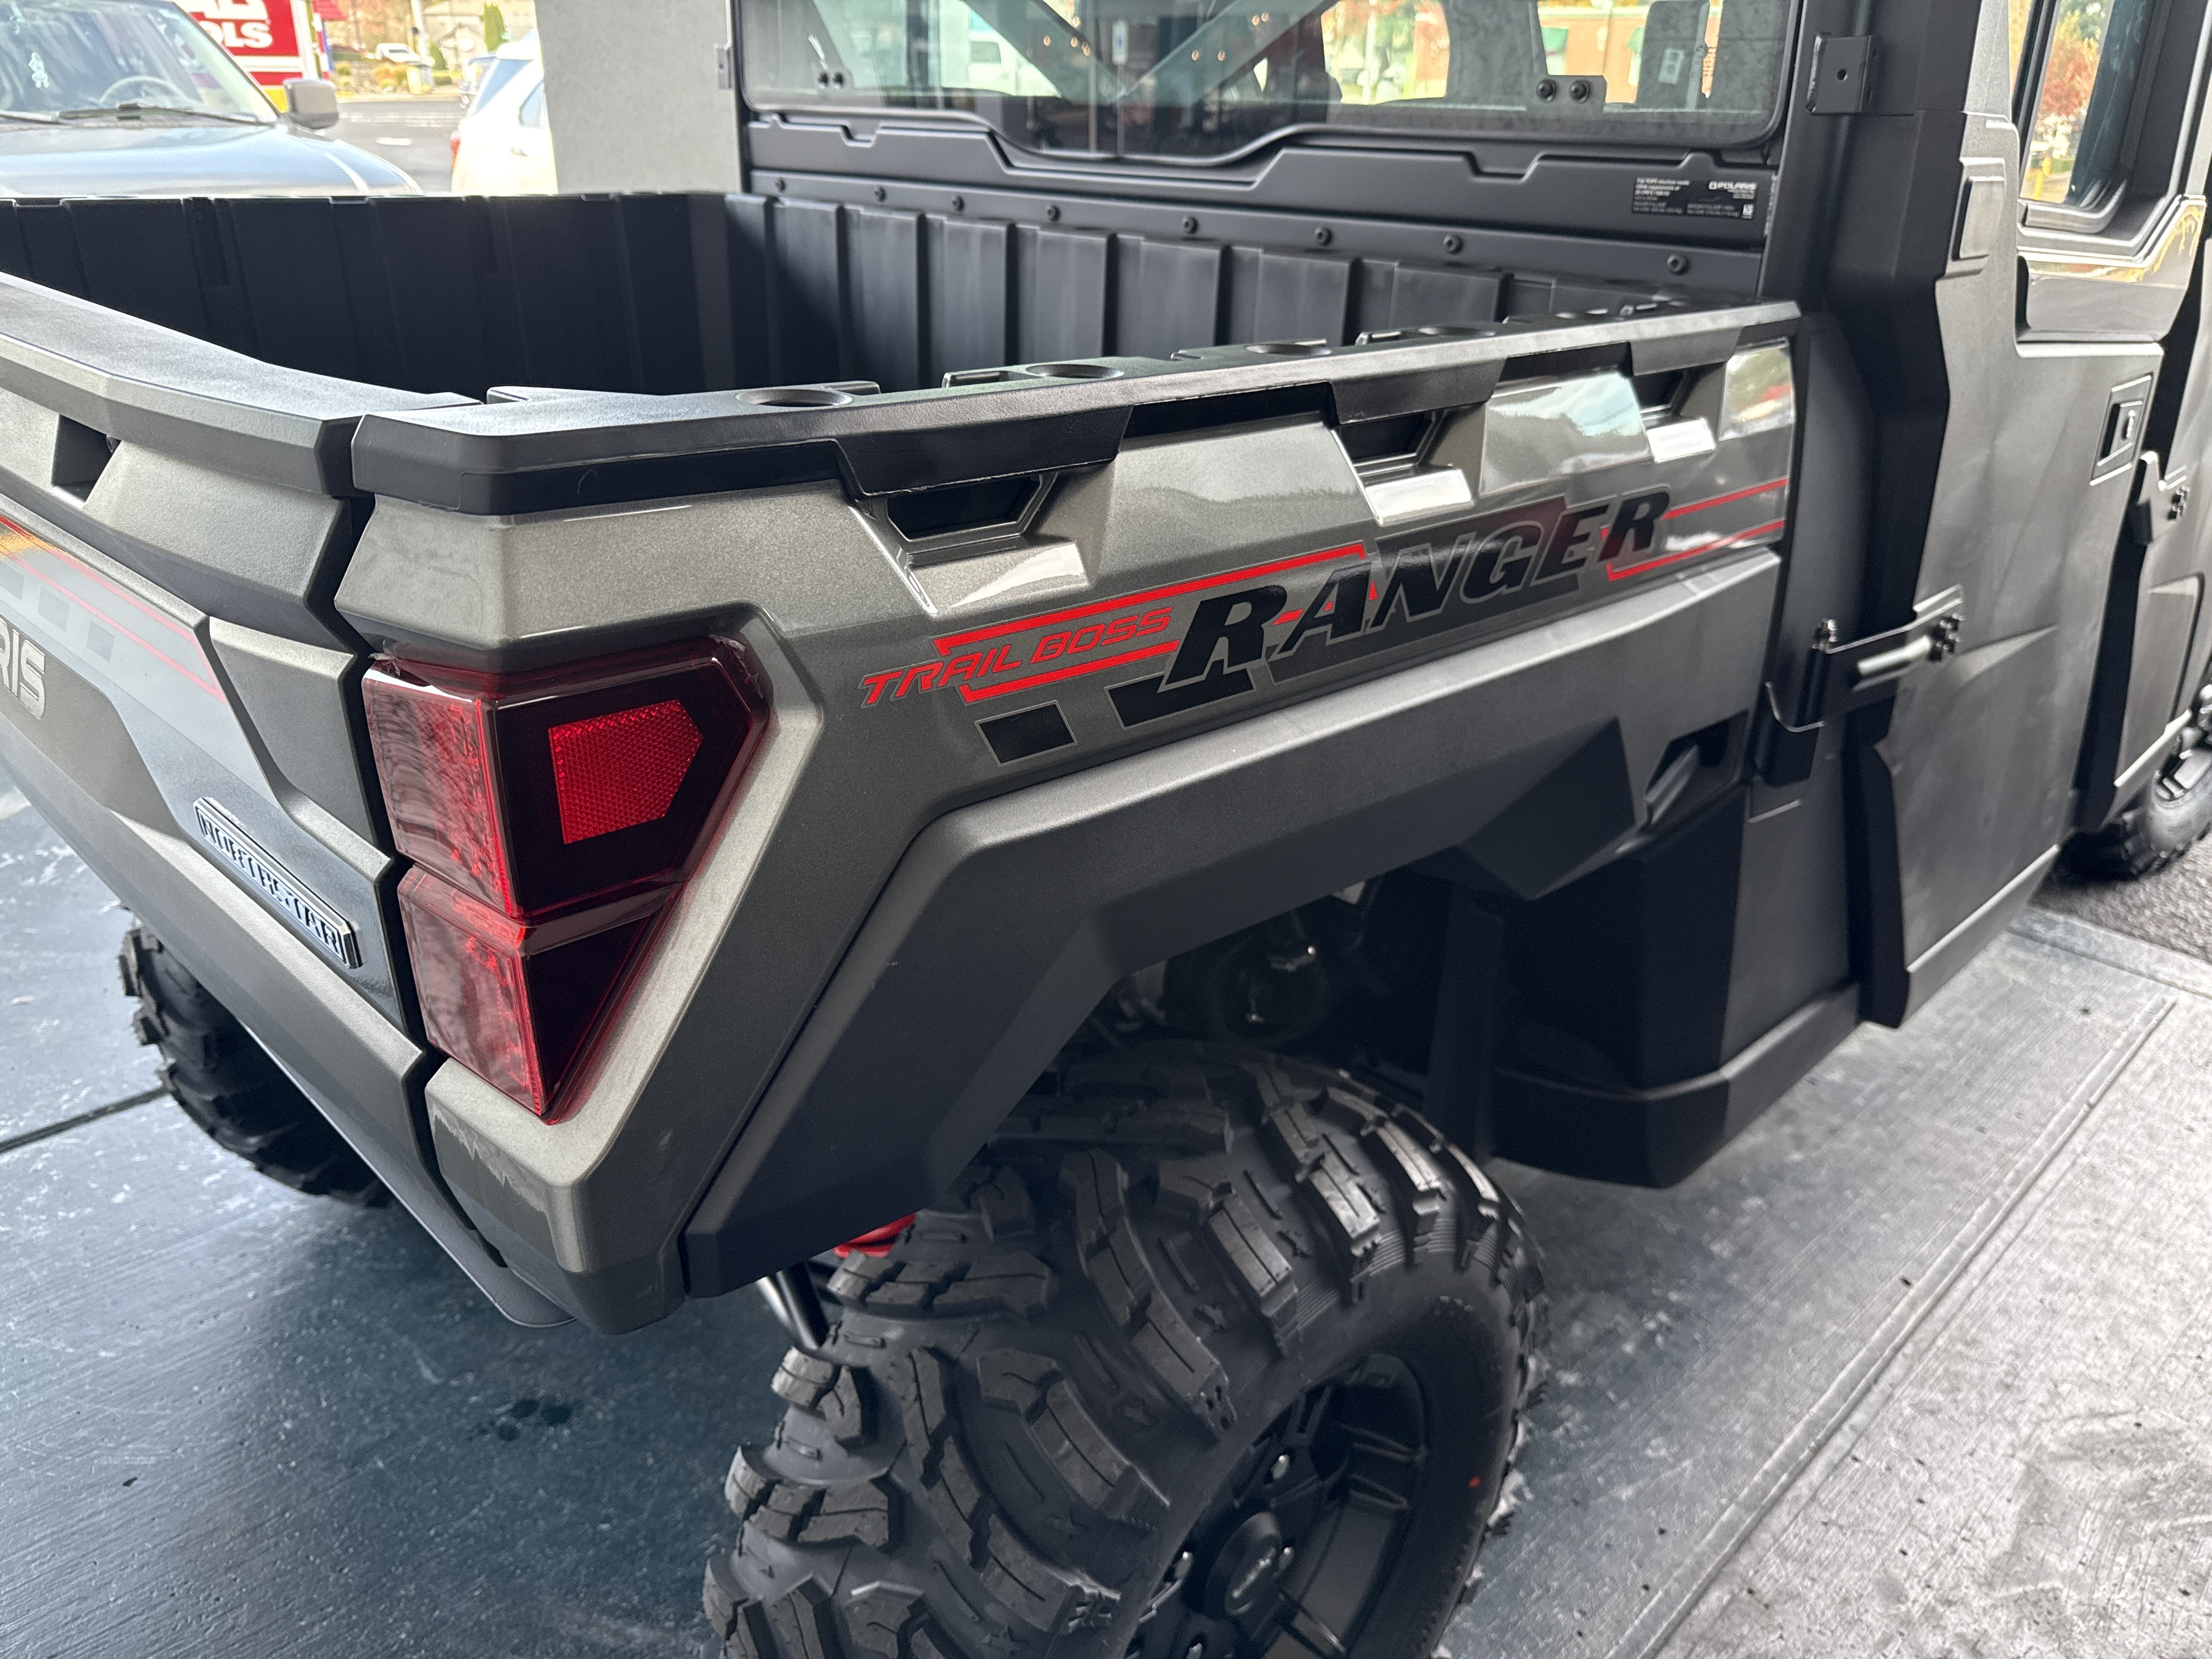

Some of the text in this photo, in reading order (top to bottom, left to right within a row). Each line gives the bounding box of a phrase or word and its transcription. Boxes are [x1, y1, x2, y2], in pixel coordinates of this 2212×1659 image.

[864, 607, 1173, 704] TRAIL BOSS
[1160, 486, 1670, 692] RANGER
[199, 812, 341, 957] NORTHSTAR
